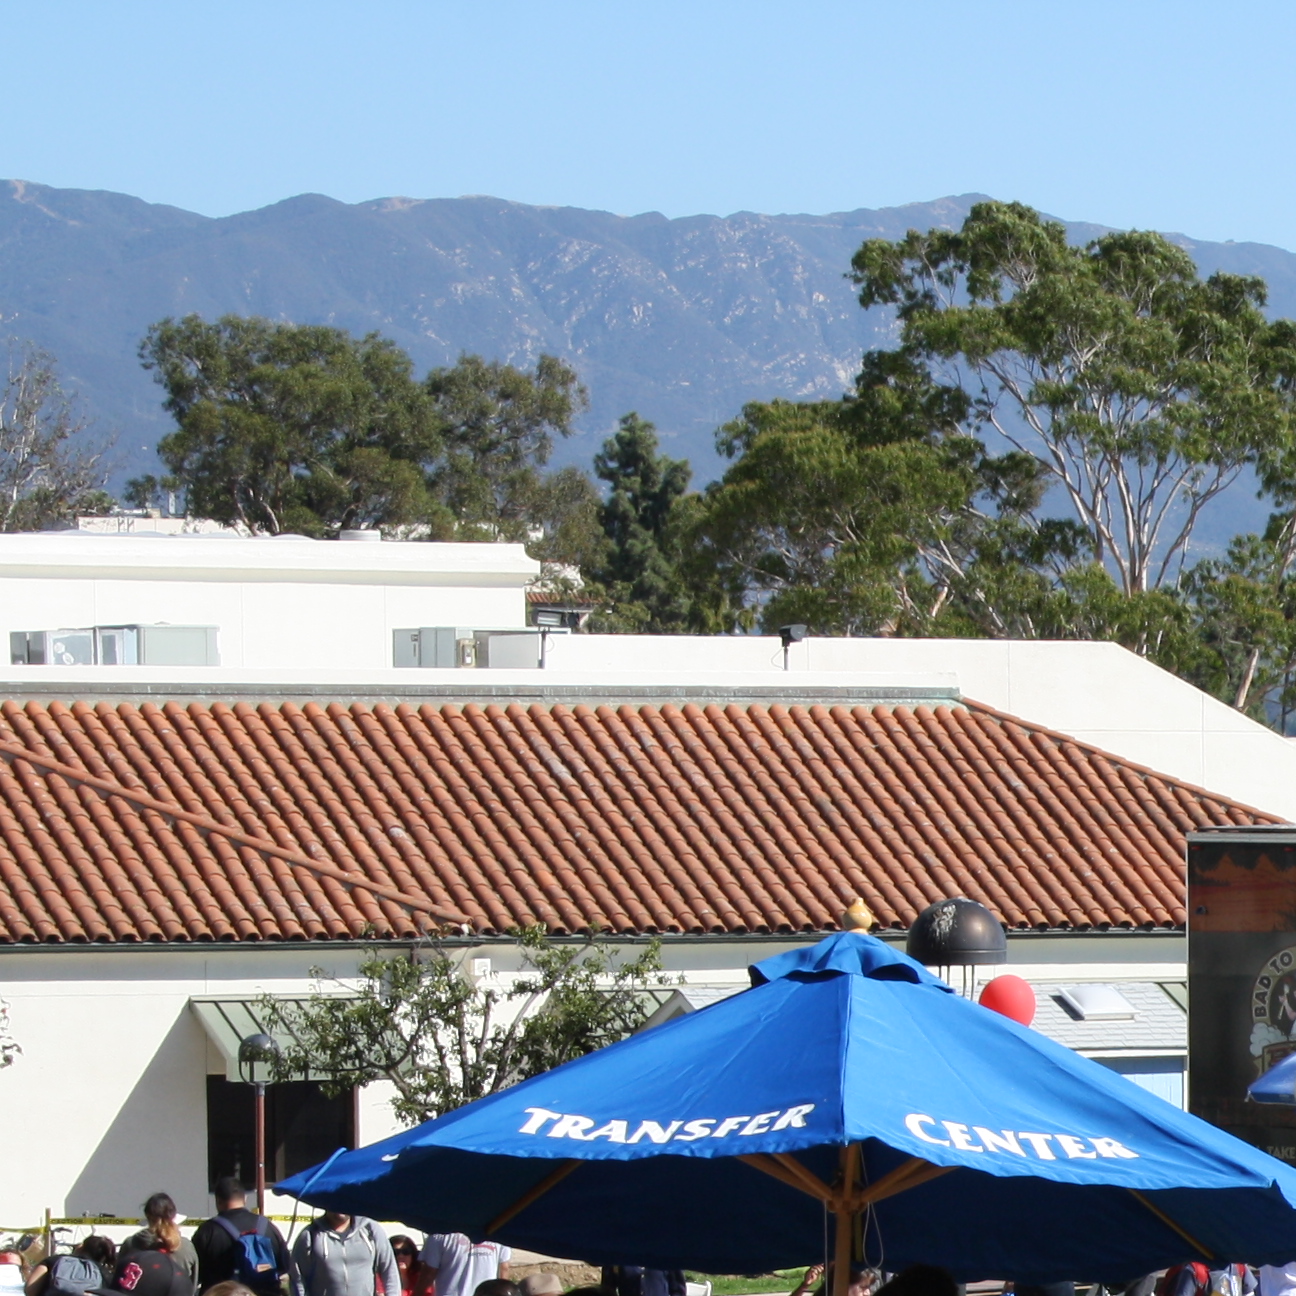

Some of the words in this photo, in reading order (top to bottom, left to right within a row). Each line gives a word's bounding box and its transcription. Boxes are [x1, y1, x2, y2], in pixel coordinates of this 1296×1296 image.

[1254, 975, 1272, 1018] BAD
[1269, 951, 1293, 974] TO
[519, 1103, 815, 1145] TRANSFER
[905, 1113, 1140, 1161] CENTER
